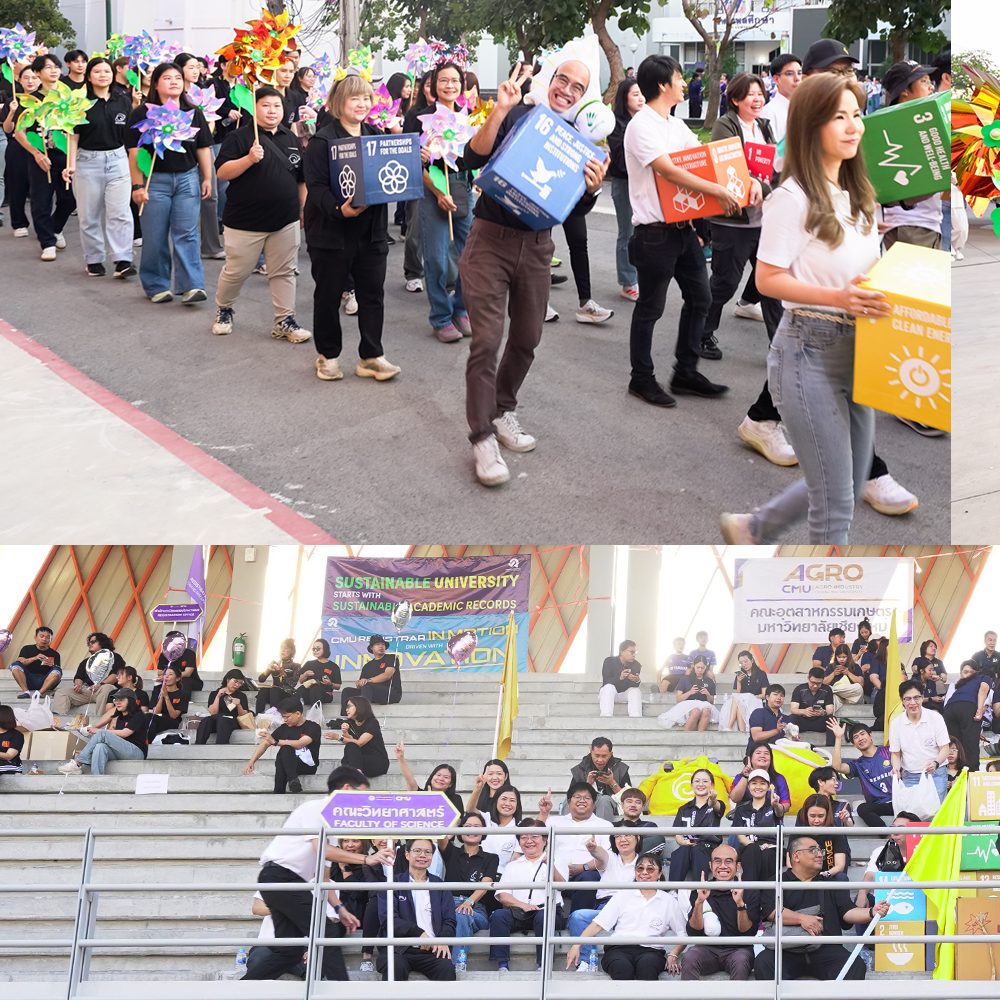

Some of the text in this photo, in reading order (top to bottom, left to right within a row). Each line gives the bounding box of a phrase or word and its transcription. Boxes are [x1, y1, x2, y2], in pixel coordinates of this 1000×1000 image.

[534, 113, 555, 136] 16
[913, 111, 934, 124] 3
[331, 145, 338, 160] 17
[366, 138, 413, 157] 17 PARTNERSHIPS
[380, 146, 413, 156] FOR THE GOALS
[928, 127, 950, 171] GOOD HEALTH
[918, 130, 943, 181] AND WELL-BEING
[892, 317, 924, 337] CLEAN
[782, 564, 864, 582] AGRO
[335, 574, 520, 590] SUSTAINABLE UNIVERSITY
[781, 584, 812, 594] CMU
[333, 591, 360, 599] STARTS
[332, 599, 517, 612] SUSTAINAB CADEMIC RECORDS
[331, 636, 357, 644] CMU
[427, 630, 445, 641] IN
[332, 805, 445, 818] คณะวิทยาศาสตร์
[334, 819, 445, 828] FACULTY OF SCIENCE
